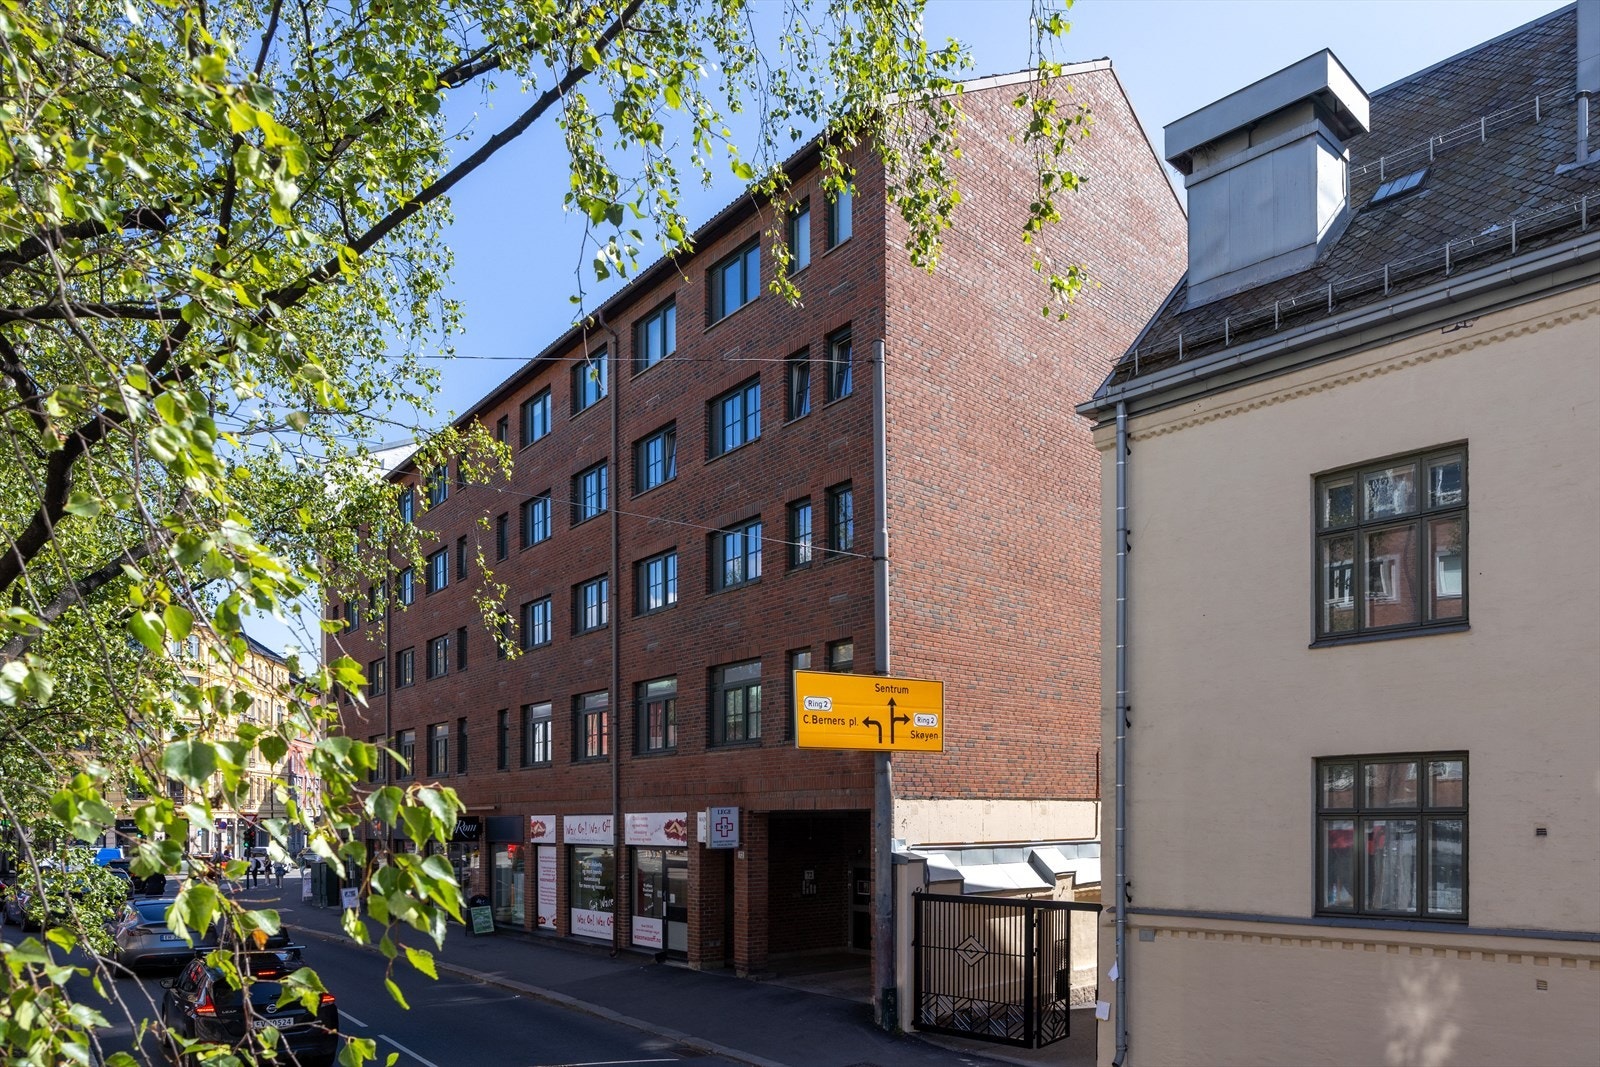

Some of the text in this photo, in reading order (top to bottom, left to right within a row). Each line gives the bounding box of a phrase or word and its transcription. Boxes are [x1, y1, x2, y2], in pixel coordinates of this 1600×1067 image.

[874, 683, 910, 695] Sentrum
[808, 699, 823, 710] Ring
[803, 714, 859, 728] C.Berners pl.
[917, 715, 930, 725] Ring
[910, 730, 939, 742] Skøyen
